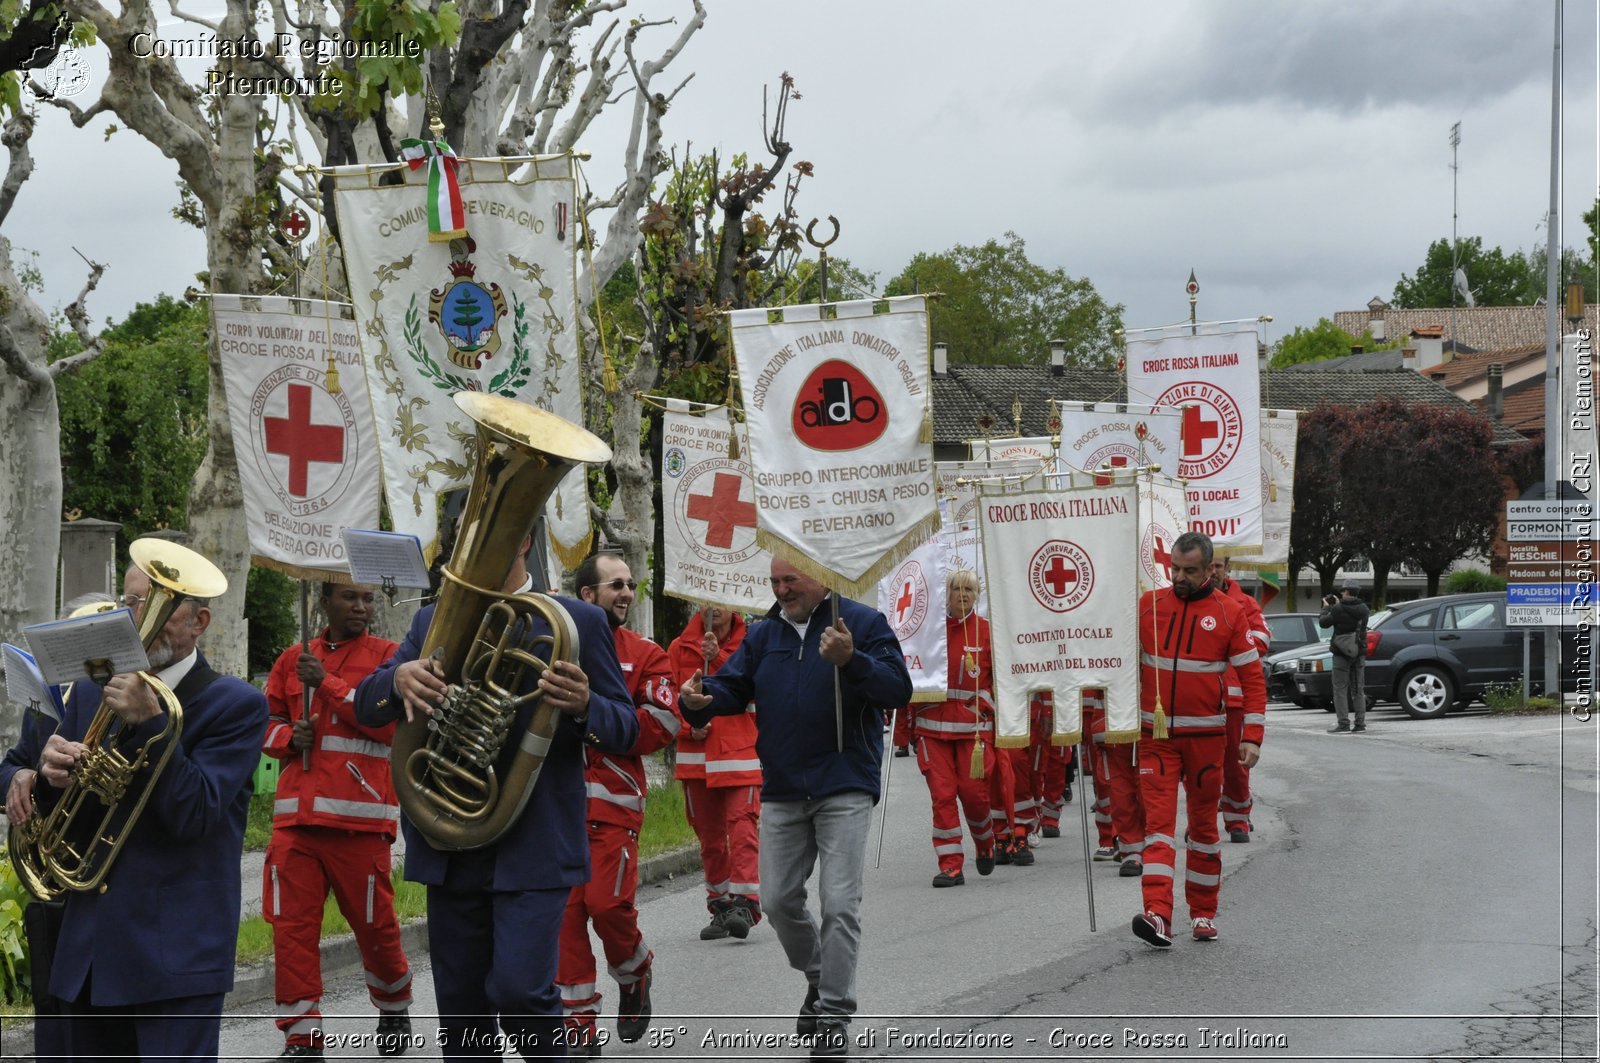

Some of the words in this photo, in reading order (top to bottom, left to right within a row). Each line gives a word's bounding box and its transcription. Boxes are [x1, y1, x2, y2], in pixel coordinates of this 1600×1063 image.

[226, 323, 251, 337] CORPO
[257, 326, 303, 342] VOLONTARI
[308, 329, 327, 345] DEL
[221, 339, 268, 357] CROCE
[273, 344, 316, 362] ROSSA
[321, 348, 363, 366] ITALIA
[1142, 358, 1170, 374] CROCE
[1172, 356, 1200, 371] ROSSA
[1201, 353, 1239, 368] ITALIANA
[752, 344, 797, 412] ASSOCIAZIONE
[796, 330, 845, 353] ITALIANA
[852, 330, 900, 363] DONATORI
[897, 359, 922, 397] ORGANI
[252, 367, 301, 417] CONVENZIONE
[306, 369, 318, 382] DI
[800, 377, 879, 428] aido
[1200, 386, 1213, 399] DI
[1213, 394, 1238, 438] GINEVRA
[669, 423, 695, 436] CORPO
[697, 428, 731, 440] VOLONTA
[1073, 428, 1100, 451] CROCE
[1101, 422, 1131, 433] ROSSA
[664, 435, 704, 450] CROCE
[706, 441, 748, 456] ROSA
[1099, 449, 1105, 457] DI
[1105, 445, 1136, 457] GINEVRA
[1260, 438, 1290, 471] TALIANA
[758, 470, 813, 487] GRUPPO
[817, 458, 928, 482] INTERCOMUNALE
[1177, 462, 1207, 476] GOSTO
[1207, 451, 1229, 471] 1864
[679, 460, 734, 492] CONVENZIONE
[737, 463, 748, 472] DI
[759, 494, 810, 510] BOVES
[832, 486, 888, 506] CHIUSA
[892, 481, 930, 502] PESIO
[1187, 491, 1200, 502] TO
[1202, 488, 1240, 502] LOCALE
[988, 501, 1028, 523] CROCE
[1031, 501, 1067, 521] ROSSA
[1069, 495, 1128, 518] ITALIANA
[1189, 503, 1200, 516] di
[1510, 505, 1541, 513] centro
[264, 512, 333, 539] DELEGAZIONE
[802, 512, 895, 534] PEVERAGNO
[1511, 523, 1572, 533] FORMONT
[268, 529, 344, 560] PEVERAGNO
[1039, 553, 1047, 562] DI
[1073, 551, 1083, 562] 22
[1510, 552, 1558, 561] MESCHIE
[677, 561, 715, 578] COMITATO
[726, 572, 768, 587] LOCALE
[1033, 561, 1055, 607] CONVENZIONE
[1079, 561, 1090, 592] AGOSTO
[1509, 569, 1546, 578] Madonna
[1549, 569, 1561, 577] dei
[684, 574, 754, 599] MORETTA
[1510, 588, 1570, 596] PRADEBONI
[1066, 591, 1083, 606] 1864
[1509, 608, 1541, 616] TRATTORIA
[1017, 629, 1065, 645] COMITATO
[1068, 627, 1113, 640] LOCALE
[1058, 644, 1067, 655] DI
[904, 655, 922, 670] TA
[1011, 661, 1064, 675] SOMMARIVA
[1065, 657, 1086, 670] DEL
[1088, 657, 1122, 669] BOSCO
